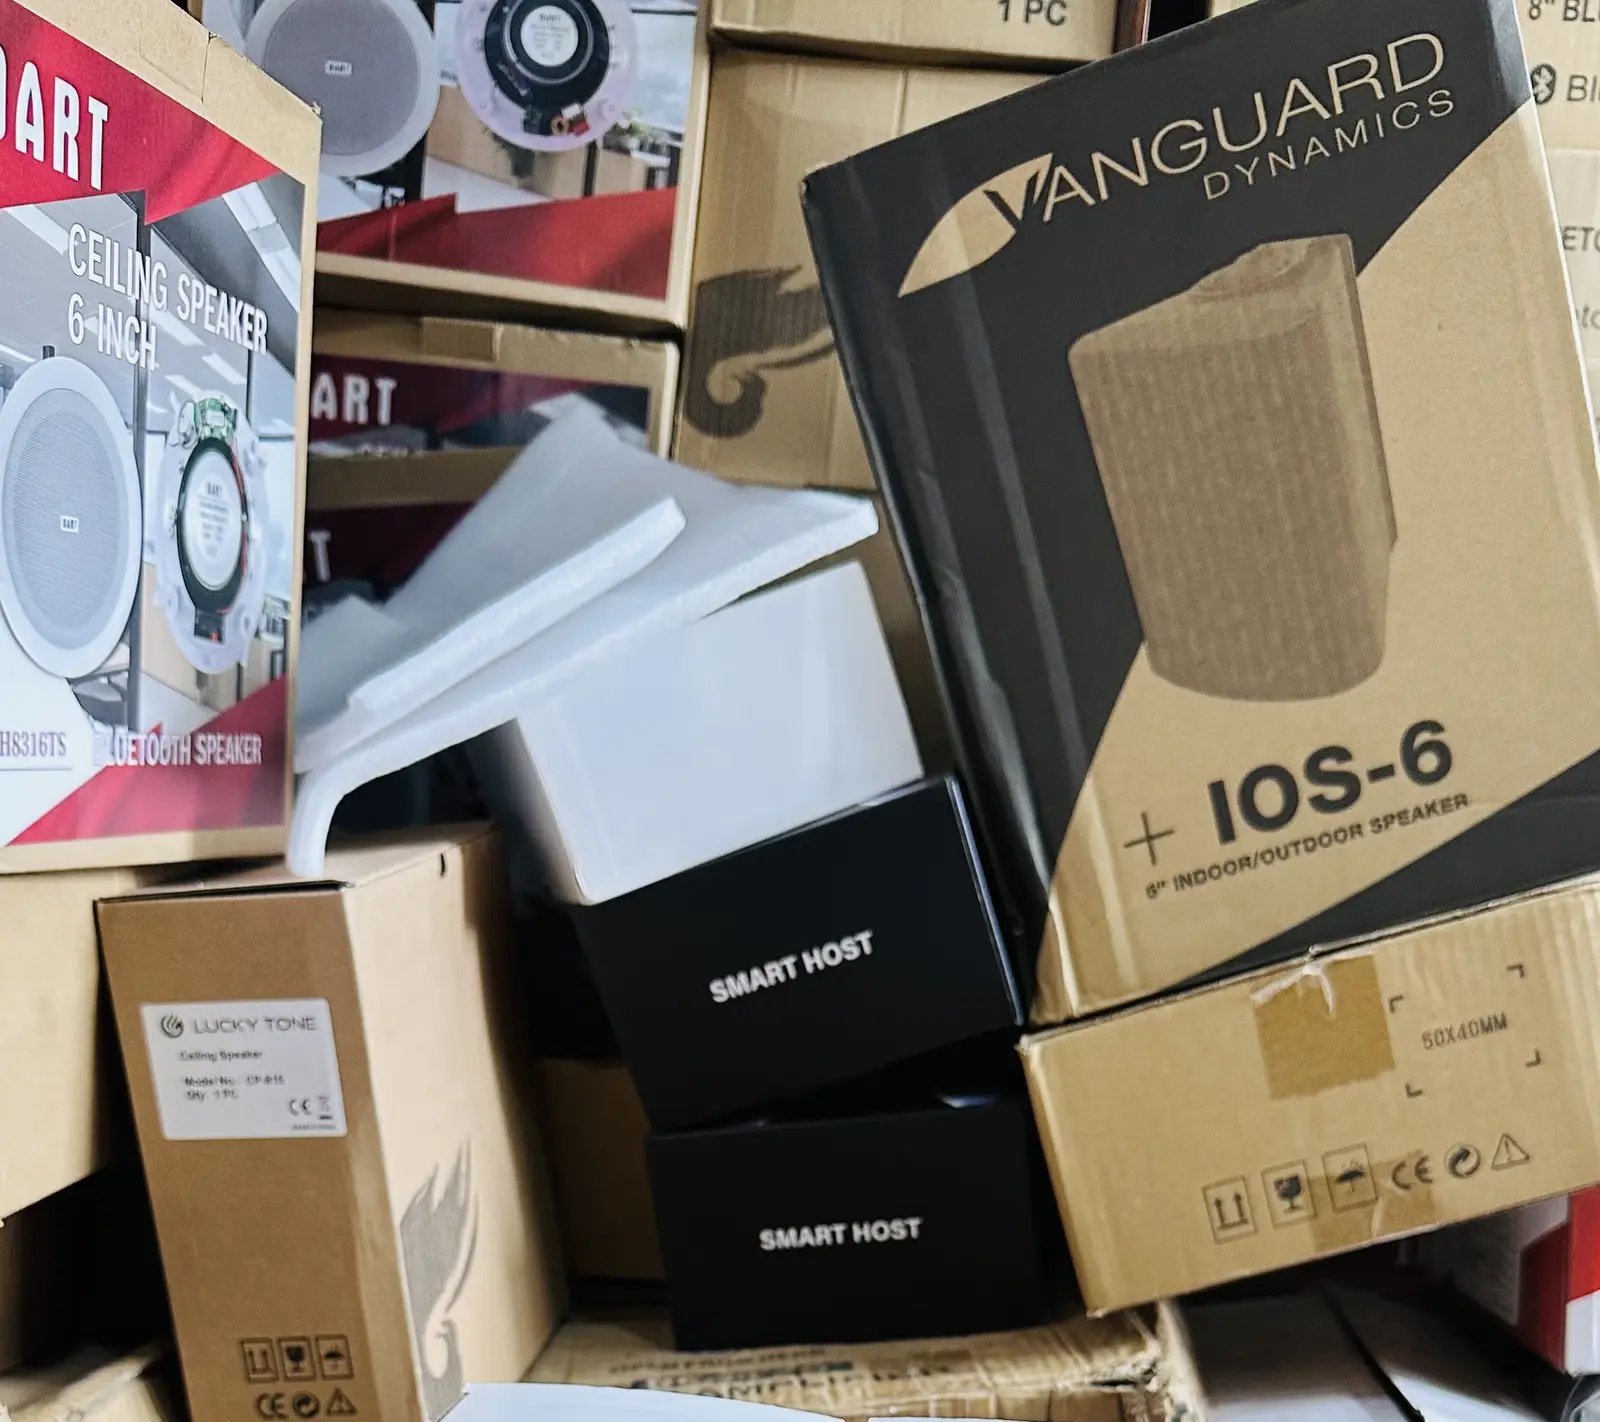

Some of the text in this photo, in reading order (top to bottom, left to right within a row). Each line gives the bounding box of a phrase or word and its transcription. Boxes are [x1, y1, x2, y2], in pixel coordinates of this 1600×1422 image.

[1025, 0, 1067, 26] PC
[1563, 0, 1600, 21] BL
[0, 44, 109, 191] ART
[1567, 75, 1600, 102] Bl
[983, 33, 1445, 223] VANGUARD
[1203, 90, 1455, 201] DYNAMICS
[68, 223, 269, 355] CEILING SPEAKER
[68, 293, 158, 372] 6 INCH
[310, 372, 397, 425] ART
[194, 734, 263, 766] SPEAKER
[1207, 719, 1453, 846] IOS-6
[1173, 823, 1364, 892] INDOOR/OUTDOOR
[1369, 793, 1469, 834] SPEAKER
[708, 929, 873, 1003] SMART HOST
[194, 1016, 317, 1034] LUCKY TONE
[759, 1216, 923, 1251] SMART HOST
